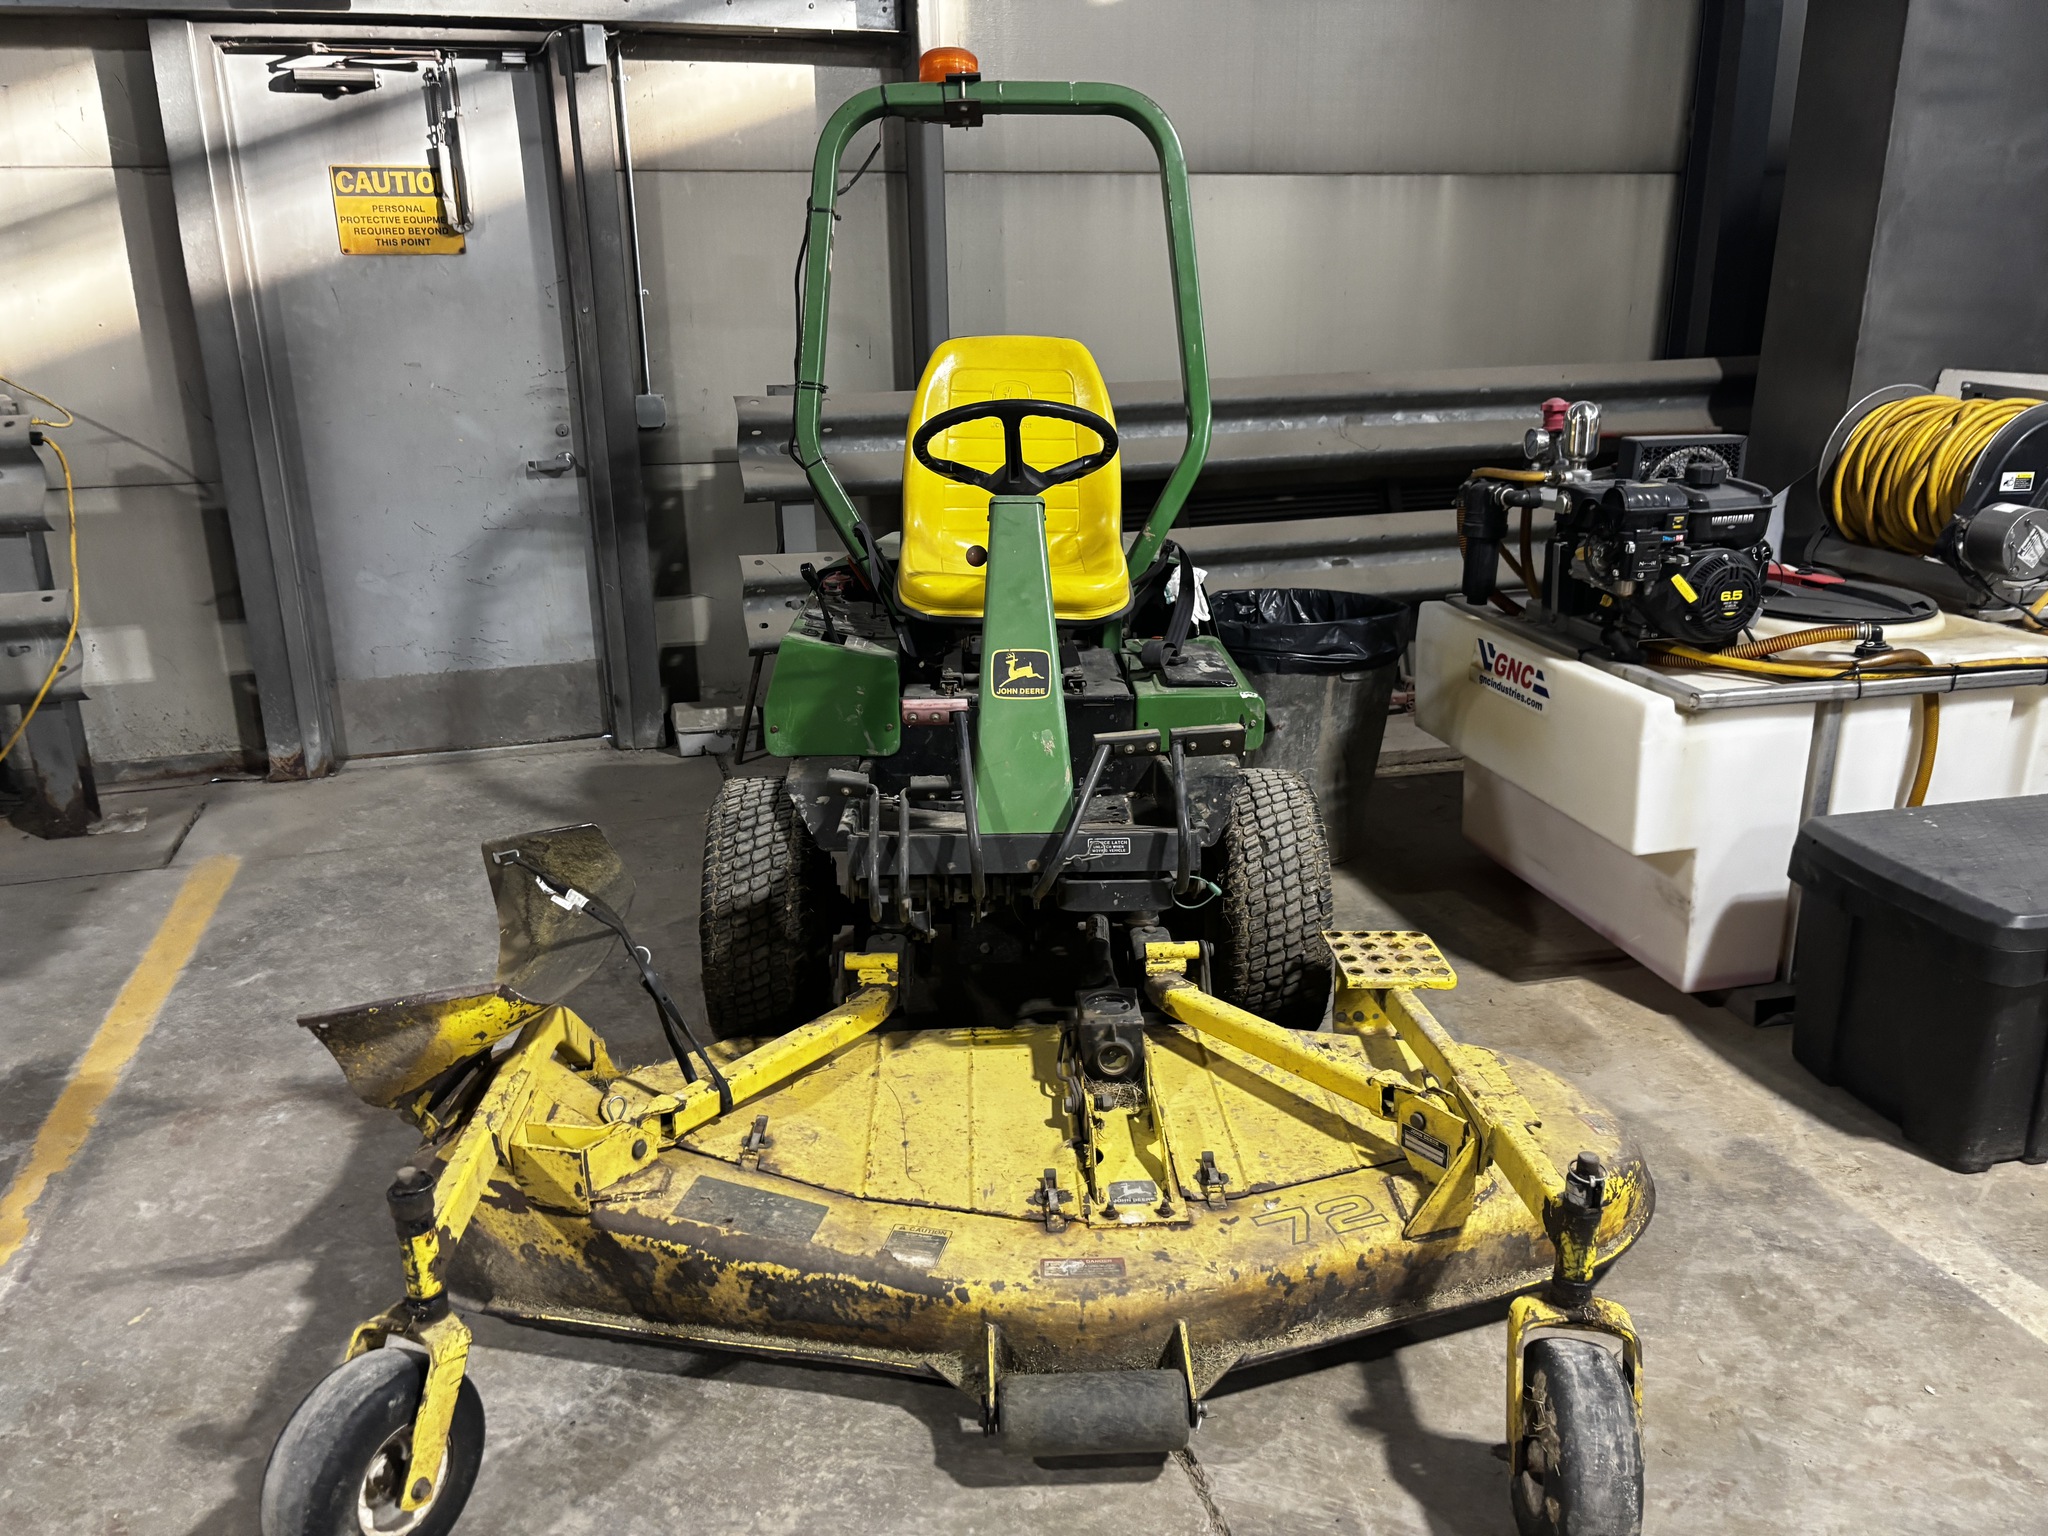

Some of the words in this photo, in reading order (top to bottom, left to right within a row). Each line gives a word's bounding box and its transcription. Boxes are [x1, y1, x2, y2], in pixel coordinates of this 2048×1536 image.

[335, 170, 442, 194] CAUTIO
[372, 205, 426, 213] PERSONAL
[340, 216, 401, 224] PROTECTIVE
[403, 216, 447, 224] EQUIPME
[353, 227, 405, 235] REQUIRED
[408, 227, 449, 235] BEYOND
[375, 238, 399, 246] THIS
[401, 238, 431, 246] POINT
[1711, 514, 1754, 526] VANGUARD
[1720, 589, 1743, 601] 6.5
[1494, 653, 1535, 690] GNC
[996, 687, 1018, 695] JOHN
[1019, 687, 1046, 695] DEERE
[1478, 674, 1543, 712] gncindustries.com
[1250, 1194, 1390, 1246] 72
[909, 1227, 948, 1236] CAUTION
